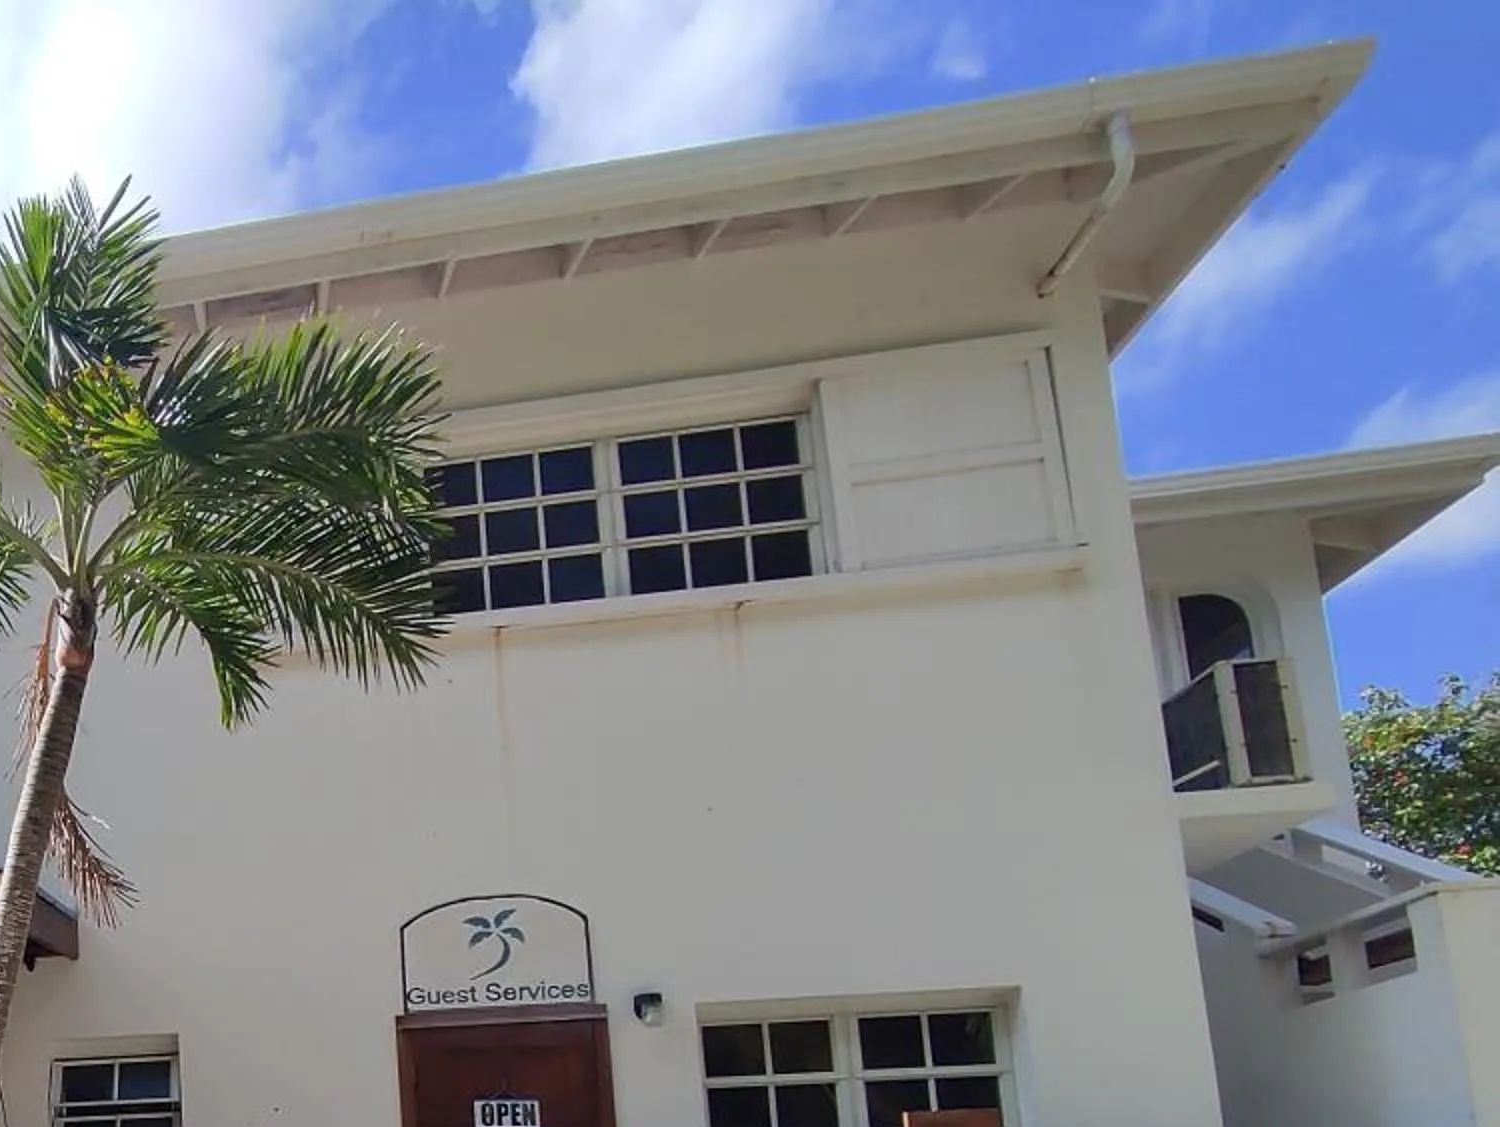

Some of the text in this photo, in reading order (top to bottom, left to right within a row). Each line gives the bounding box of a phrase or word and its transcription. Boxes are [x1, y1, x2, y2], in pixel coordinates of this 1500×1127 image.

[406, 981, 589, 1005] Guest Services
[480, 1102, 537, 1127] OPEN
